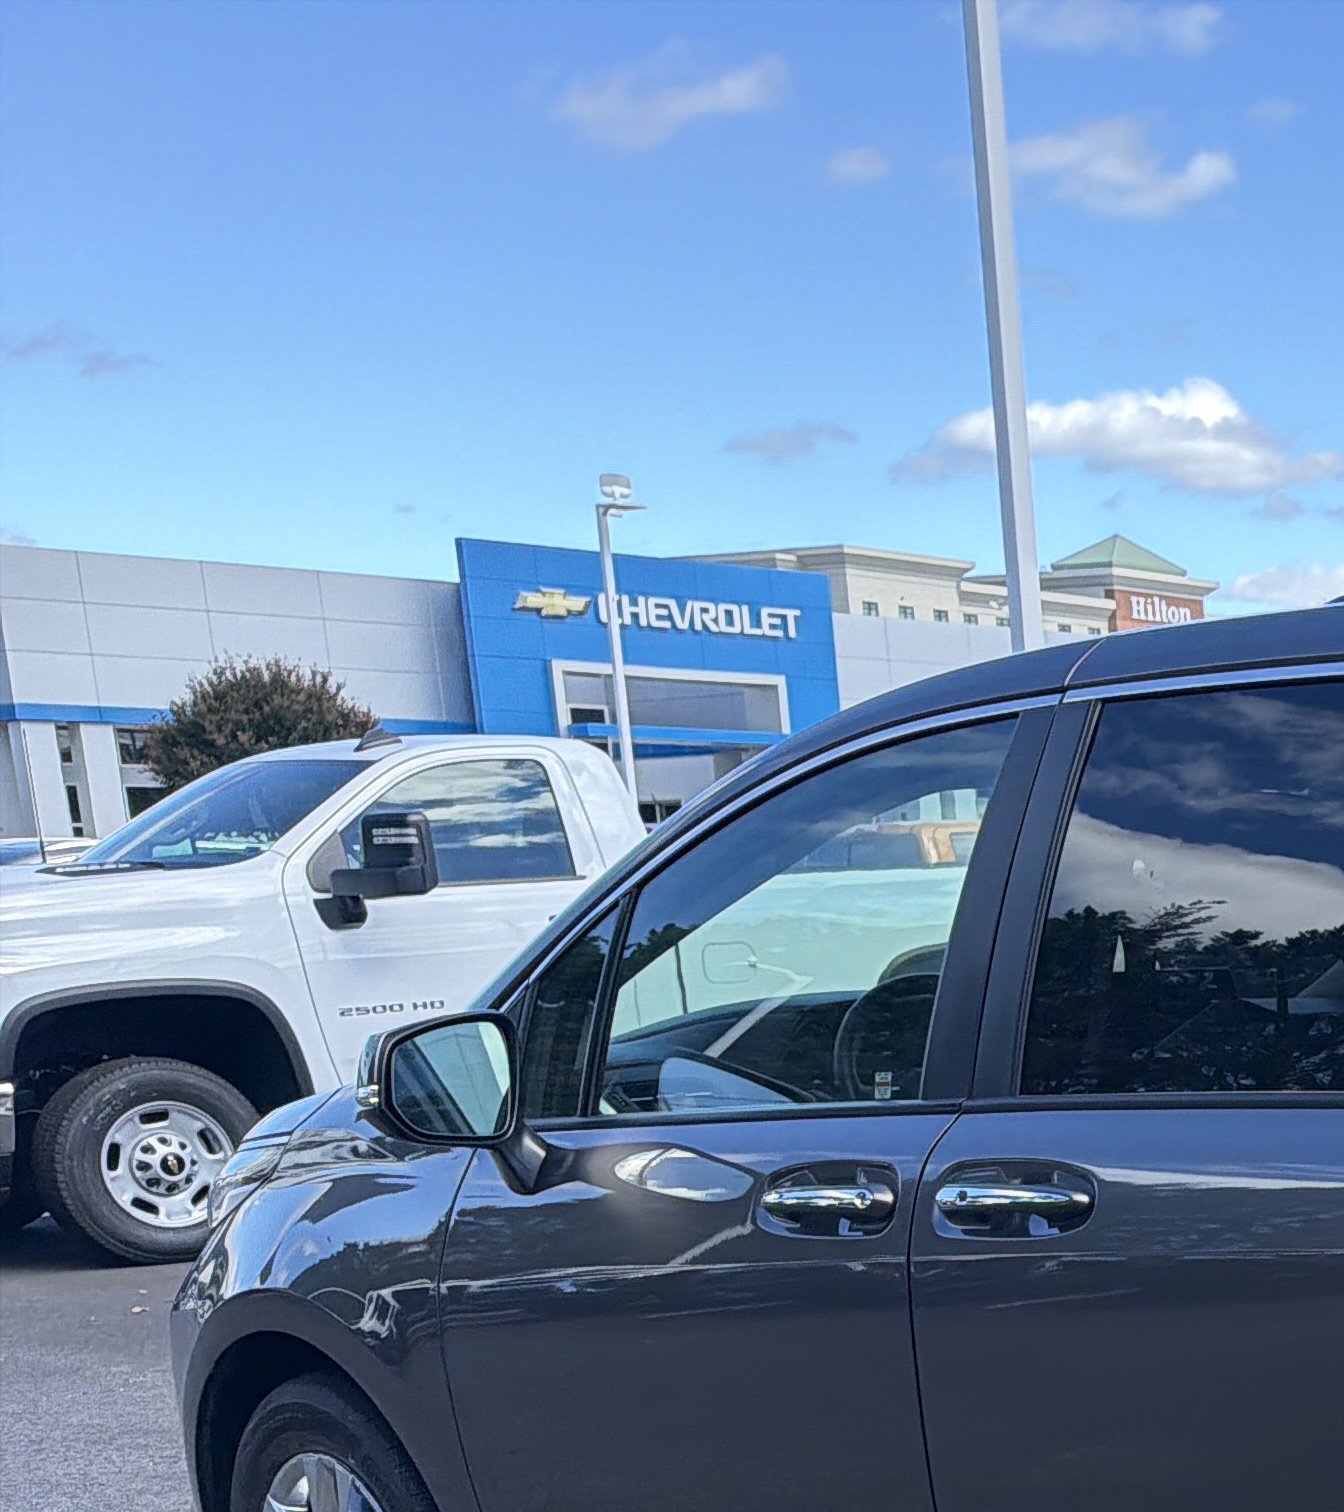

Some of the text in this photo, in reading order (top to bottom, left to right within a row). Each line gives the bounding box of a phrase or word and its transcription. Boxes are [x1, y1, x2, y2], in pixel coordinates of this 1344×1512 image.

[597, 592, 801, 639] CHEVROLET
[1130, 596, 1191, 624] Hilton
[338, 1000, 445, 1017] 2500 HD
